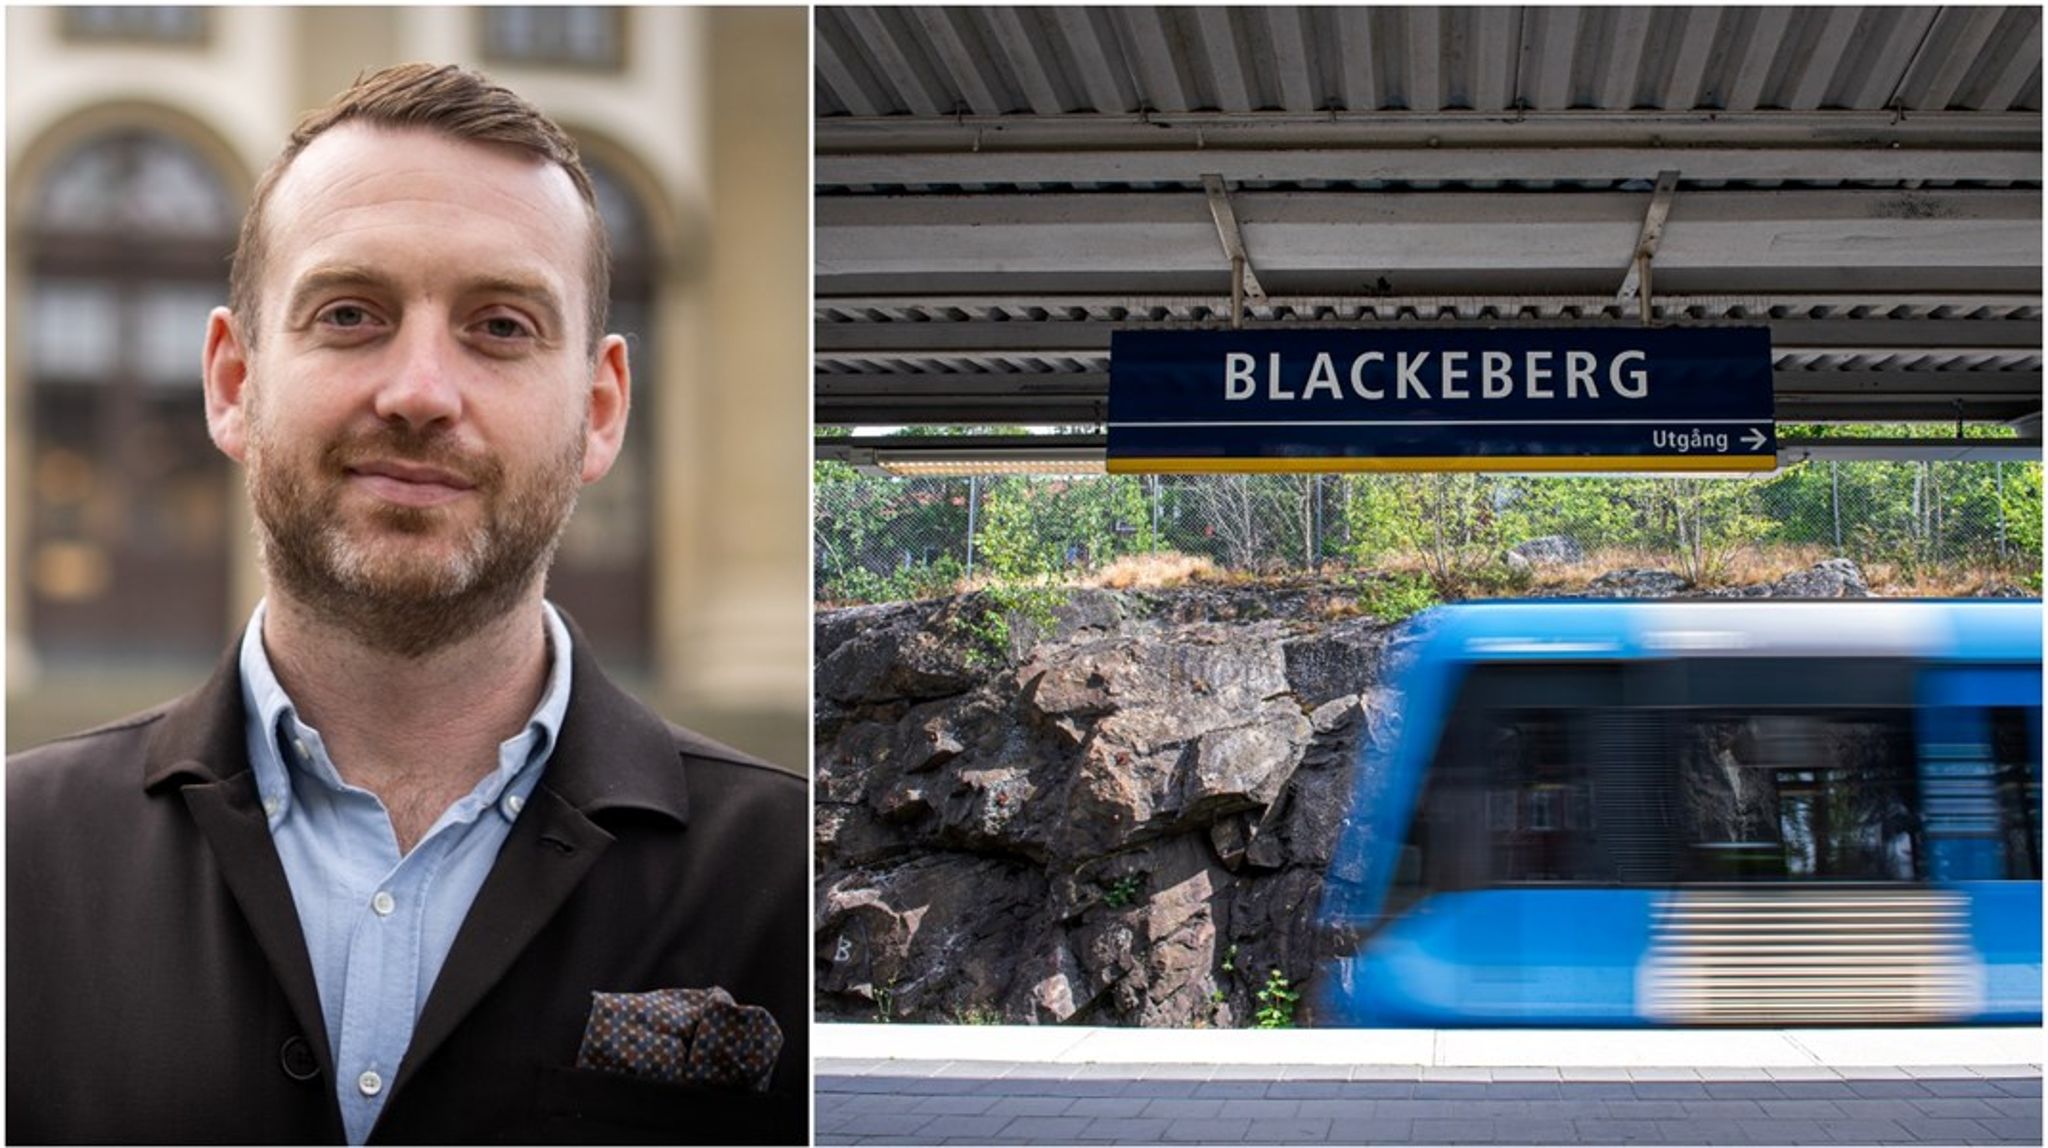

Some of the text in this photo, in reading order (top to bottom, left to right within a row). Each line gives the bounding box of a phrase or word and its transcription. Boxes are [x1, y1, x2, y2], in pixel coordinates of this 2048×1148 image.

[1224, 350, 1648, 400] BLACKEBERG
[1652, 428, 1729, 452] Utgång
[834, 935, 852, 961] B
